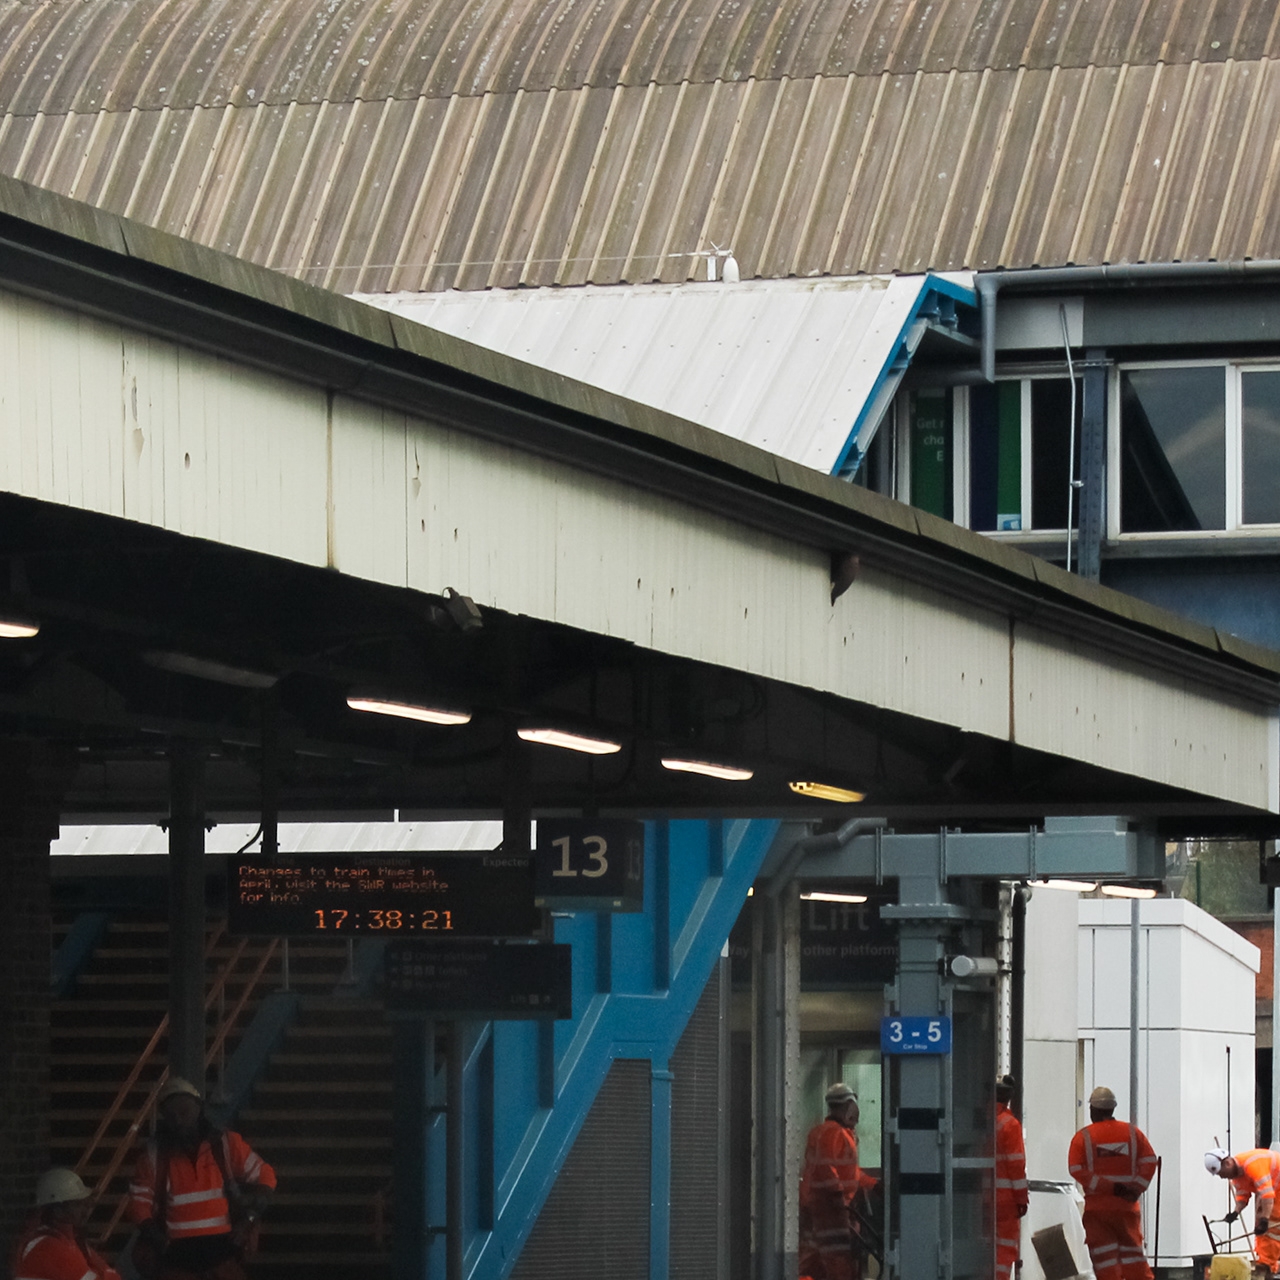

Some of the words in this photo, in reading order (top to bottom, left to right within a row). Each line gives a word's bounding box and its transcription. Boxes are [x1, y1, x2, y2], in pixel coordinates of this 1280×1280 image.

[482, 857, 529, 868] Expected
[552, 835, 609, 877] 13
[239, 866, 302, 879] Changes
[310, 867, 327, 879] to
[334, 867, 370, 879] train
[378, 867, 415, 879] times
[422, 867, 435, 878] in
[285, 879, 317, 891] visit
[325, 880, 351, 891] the
[391, 880, 449, 892] website
[240, 892, 264, 904] for
[314, 909, 455, 930] 17:38:21
[809, 901, 870, 931] Lift
[802, 945, 835, 956] other
[890, 1021, 903, 1042] 3
[928, 1021, 941, 1042] 5
